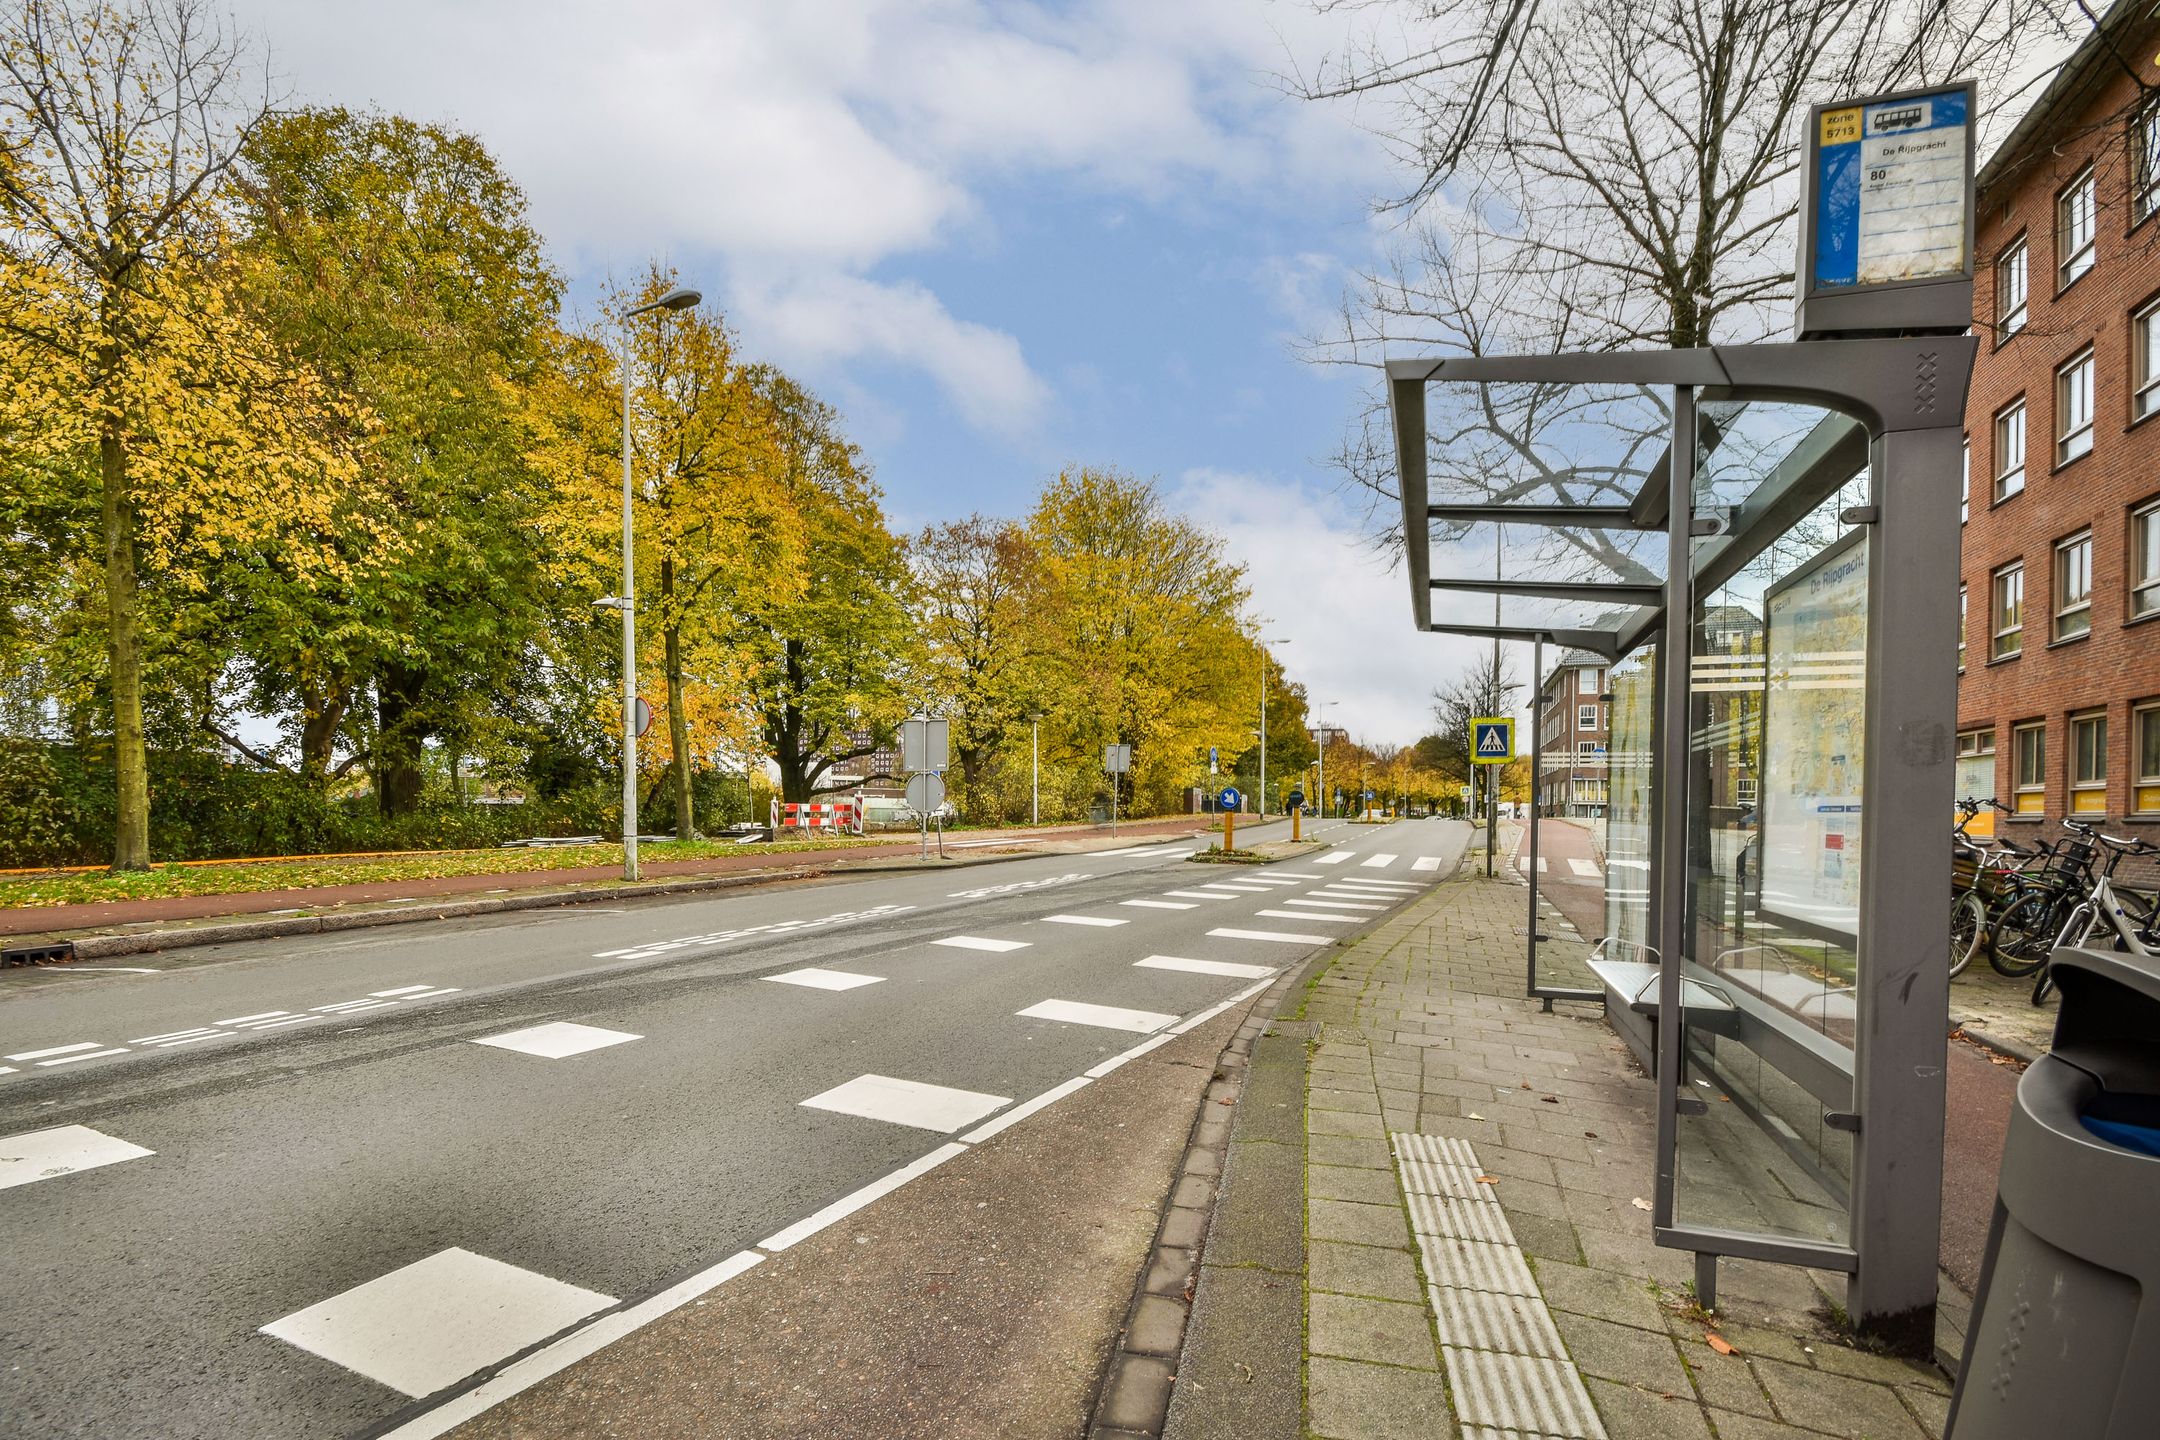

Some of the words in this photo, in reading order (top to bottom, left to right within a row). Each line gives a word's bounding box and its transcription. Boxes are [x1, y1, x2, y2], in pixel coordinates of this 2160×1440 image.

[1827, 113, 1854, 125] zone
[1826, 127, 1855, 138] 5713
[1882, 147, 1895, 156] De
[1898, 140, 1947, 154] Rijpgracht
[1870, 169, 1886, 181] 80
[1810, 579, 1820, 595] De
[1823, 552, 1864, 588] Rijpgracht
